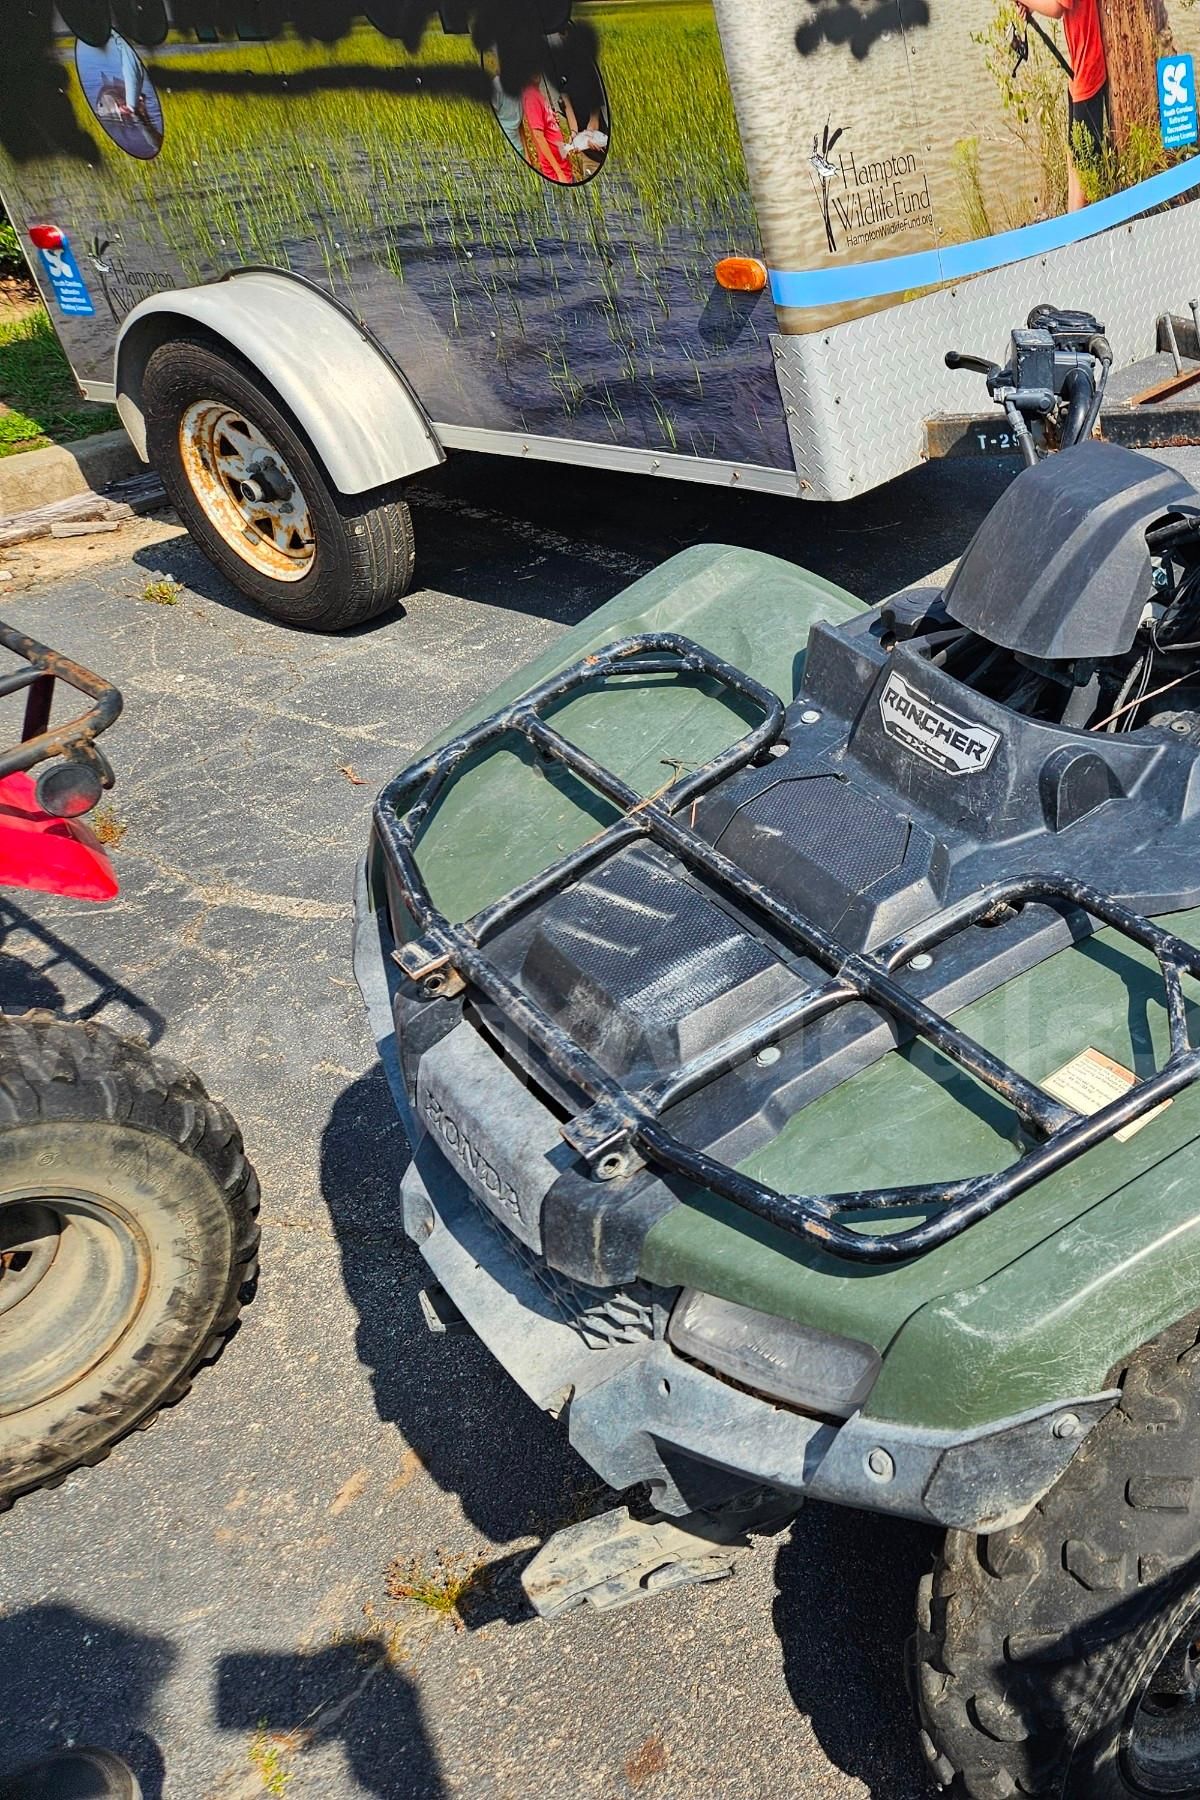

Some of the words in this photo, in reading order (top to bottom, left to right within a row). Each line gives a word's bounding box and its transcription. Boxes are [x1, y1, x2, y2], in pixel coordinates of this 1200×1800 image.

[839, 152, 917, 189] Hampton
[832, 185, 894, 231] Wildlife
[893, 174, 931, 217] Fund
[846, 213, 933, 247] HamptonWildlifeFund.org
[884, 687, 988, 762] RANCHER
[424, 1087, 526, 1226] HONDA
